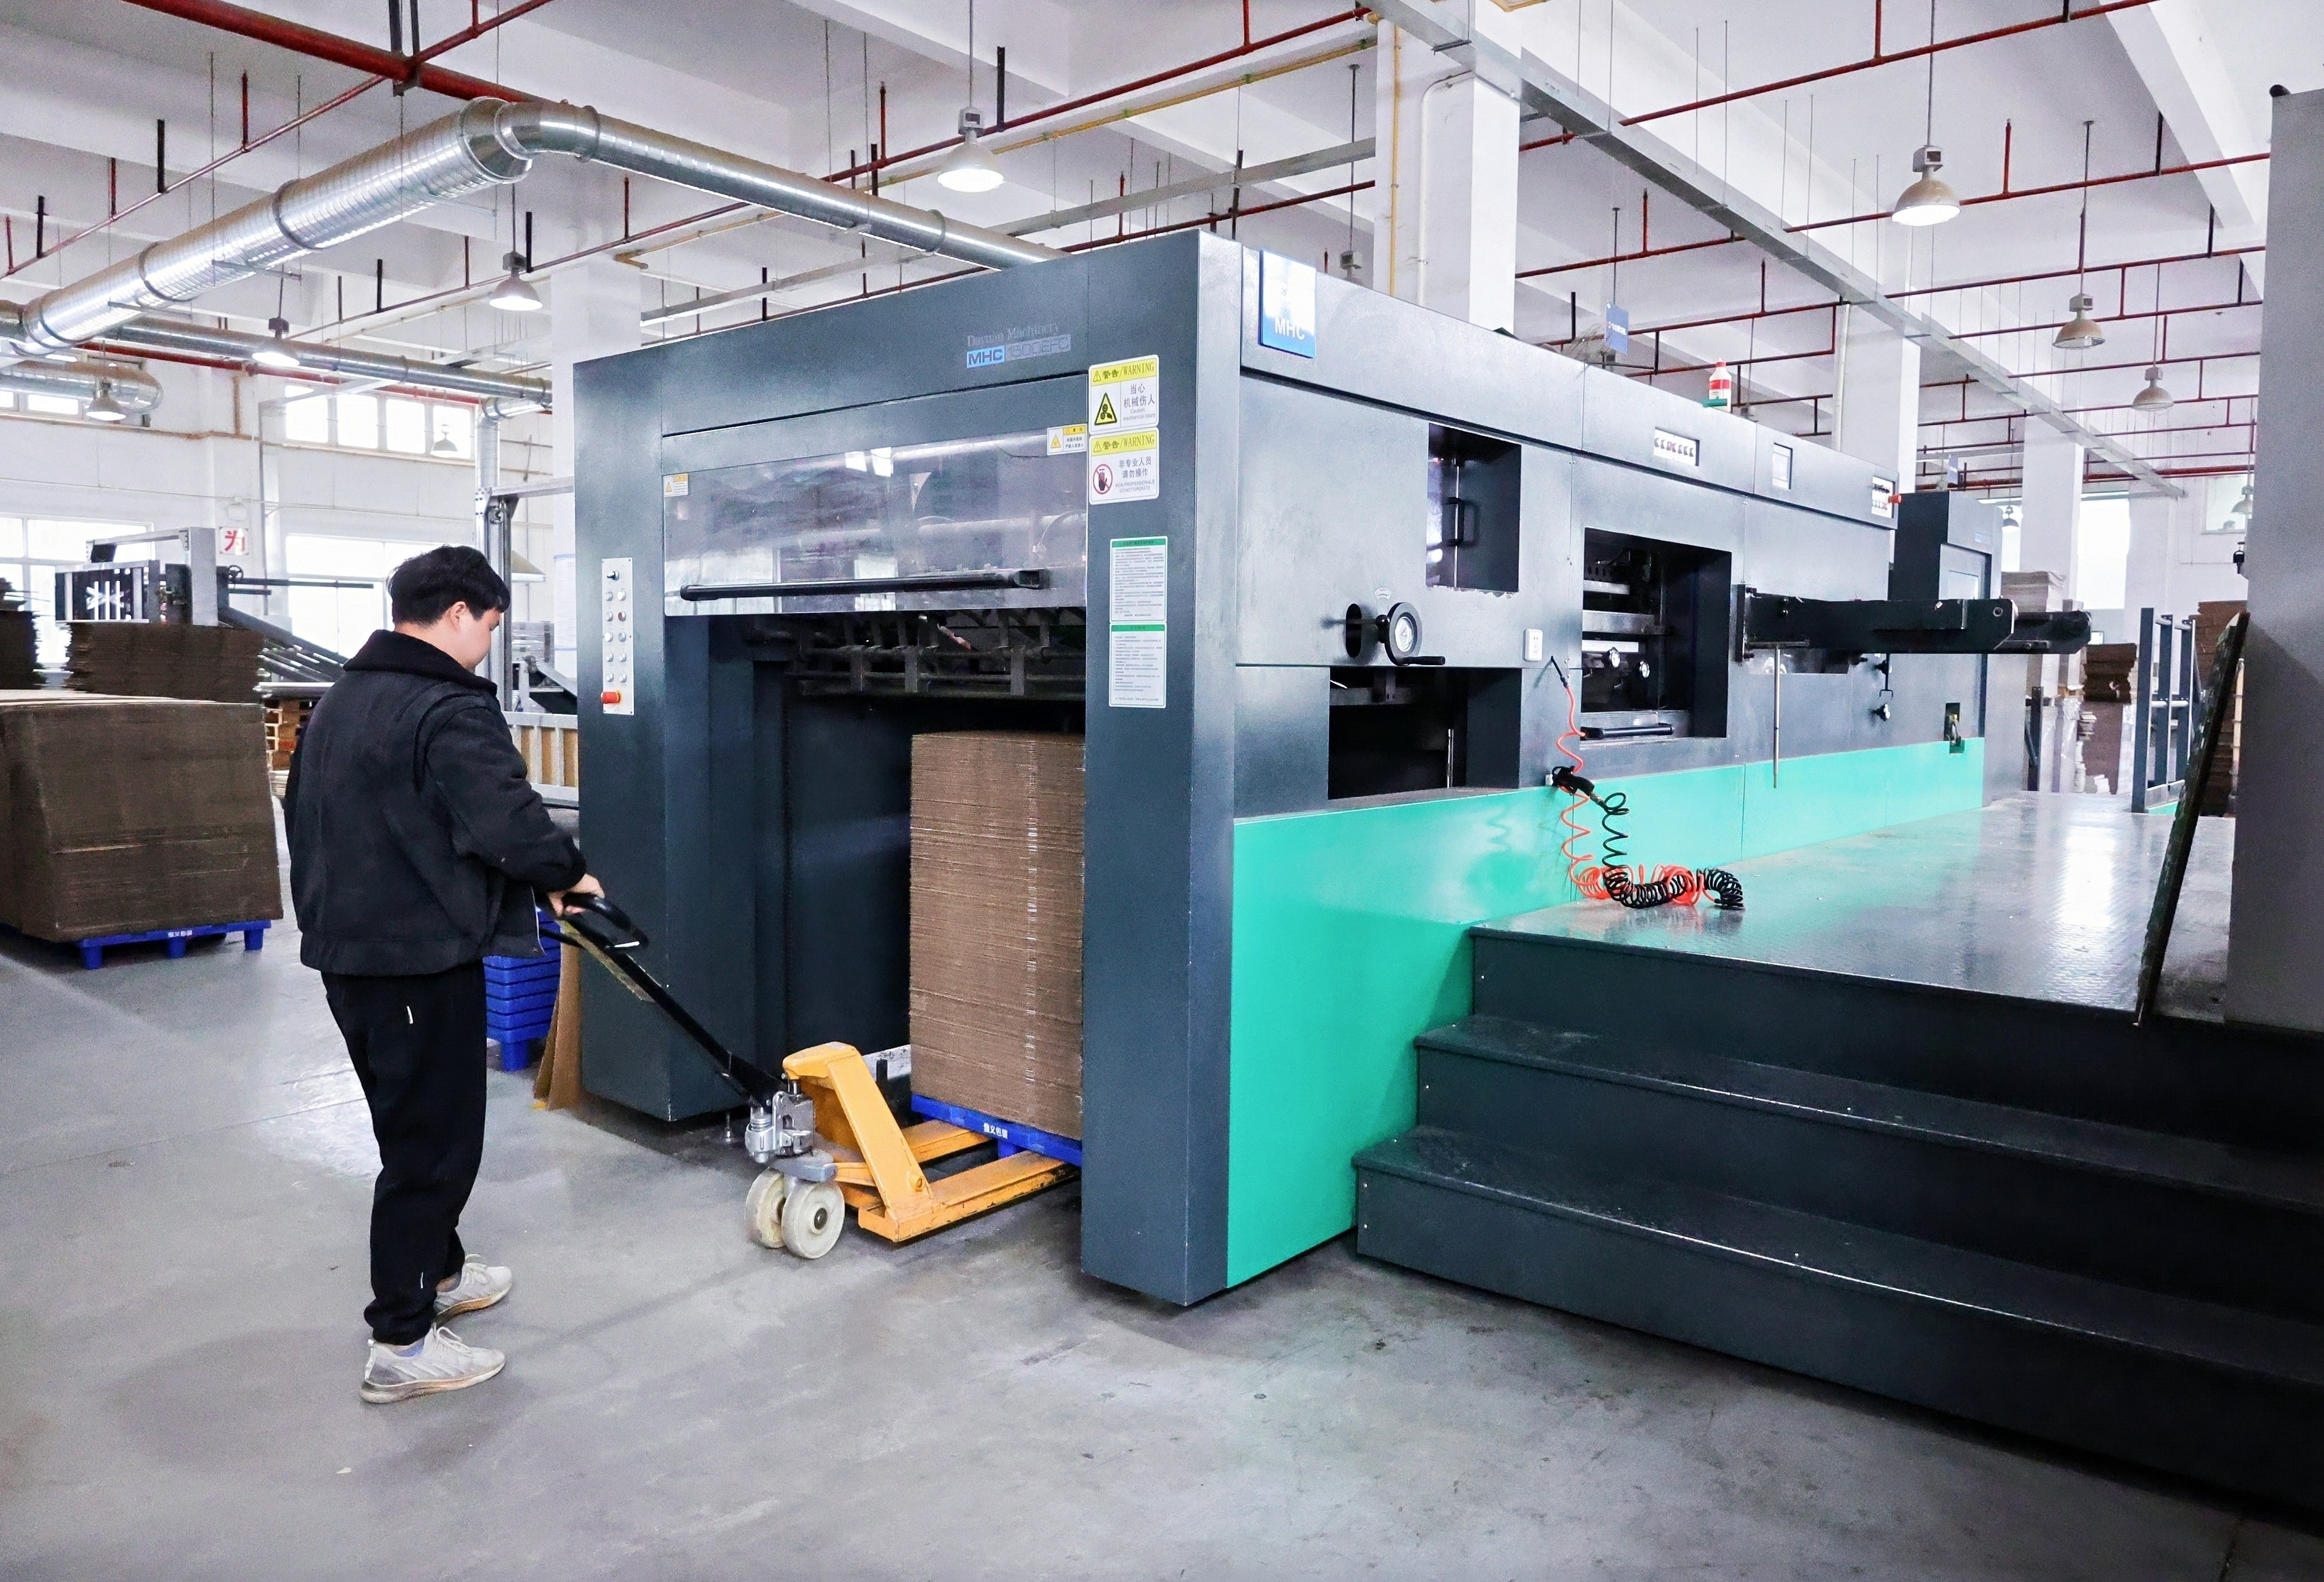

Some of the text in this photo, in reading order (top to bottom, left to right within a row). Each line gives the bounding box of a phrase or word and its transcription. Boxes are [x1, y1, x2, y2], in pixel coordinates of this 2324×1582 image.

[968, 349, 1003, 366] MHC
[1130, 383, 1146, 395] 当心
[1123, 394, 1155, 408] 机械伤人
[1119, 456, 1152, 468] 非专业人员
[1122, 467, 1148, 479] 请勿操作
